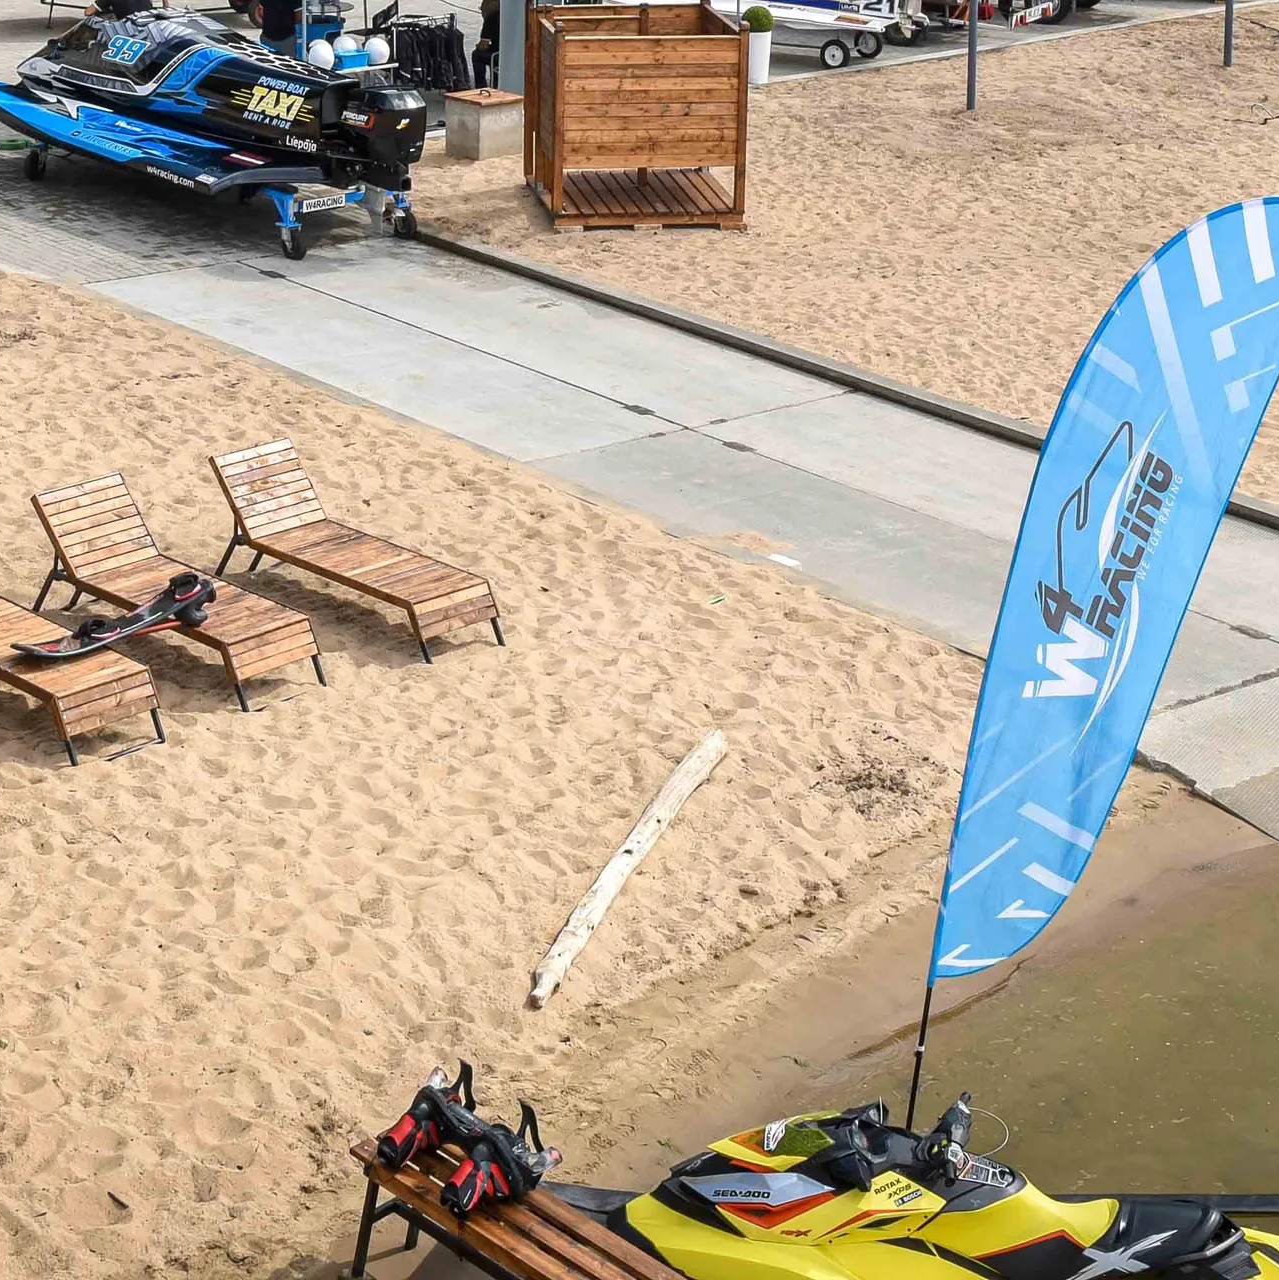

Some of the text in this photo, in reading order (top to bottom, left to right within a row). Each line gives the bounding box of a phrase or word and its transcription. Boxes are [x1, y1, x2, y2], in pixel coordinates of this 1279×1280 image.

[101, 35, 151, 65] 99
[257, 75, 312, 96] POWER BOAT
[246, 85, 306, 121] TAXI
[242, 111, 292, 130] RENT A RIDE
[145, 164, 196, 189] w4racing.com
[305, 196, 344, 211] W4RACING
[1136, 473, 1185, 581] WE FOR RACING
[873, 1177, 903, 1195] ROTAX
[903, 1190, 923, 1205] BOSCH
